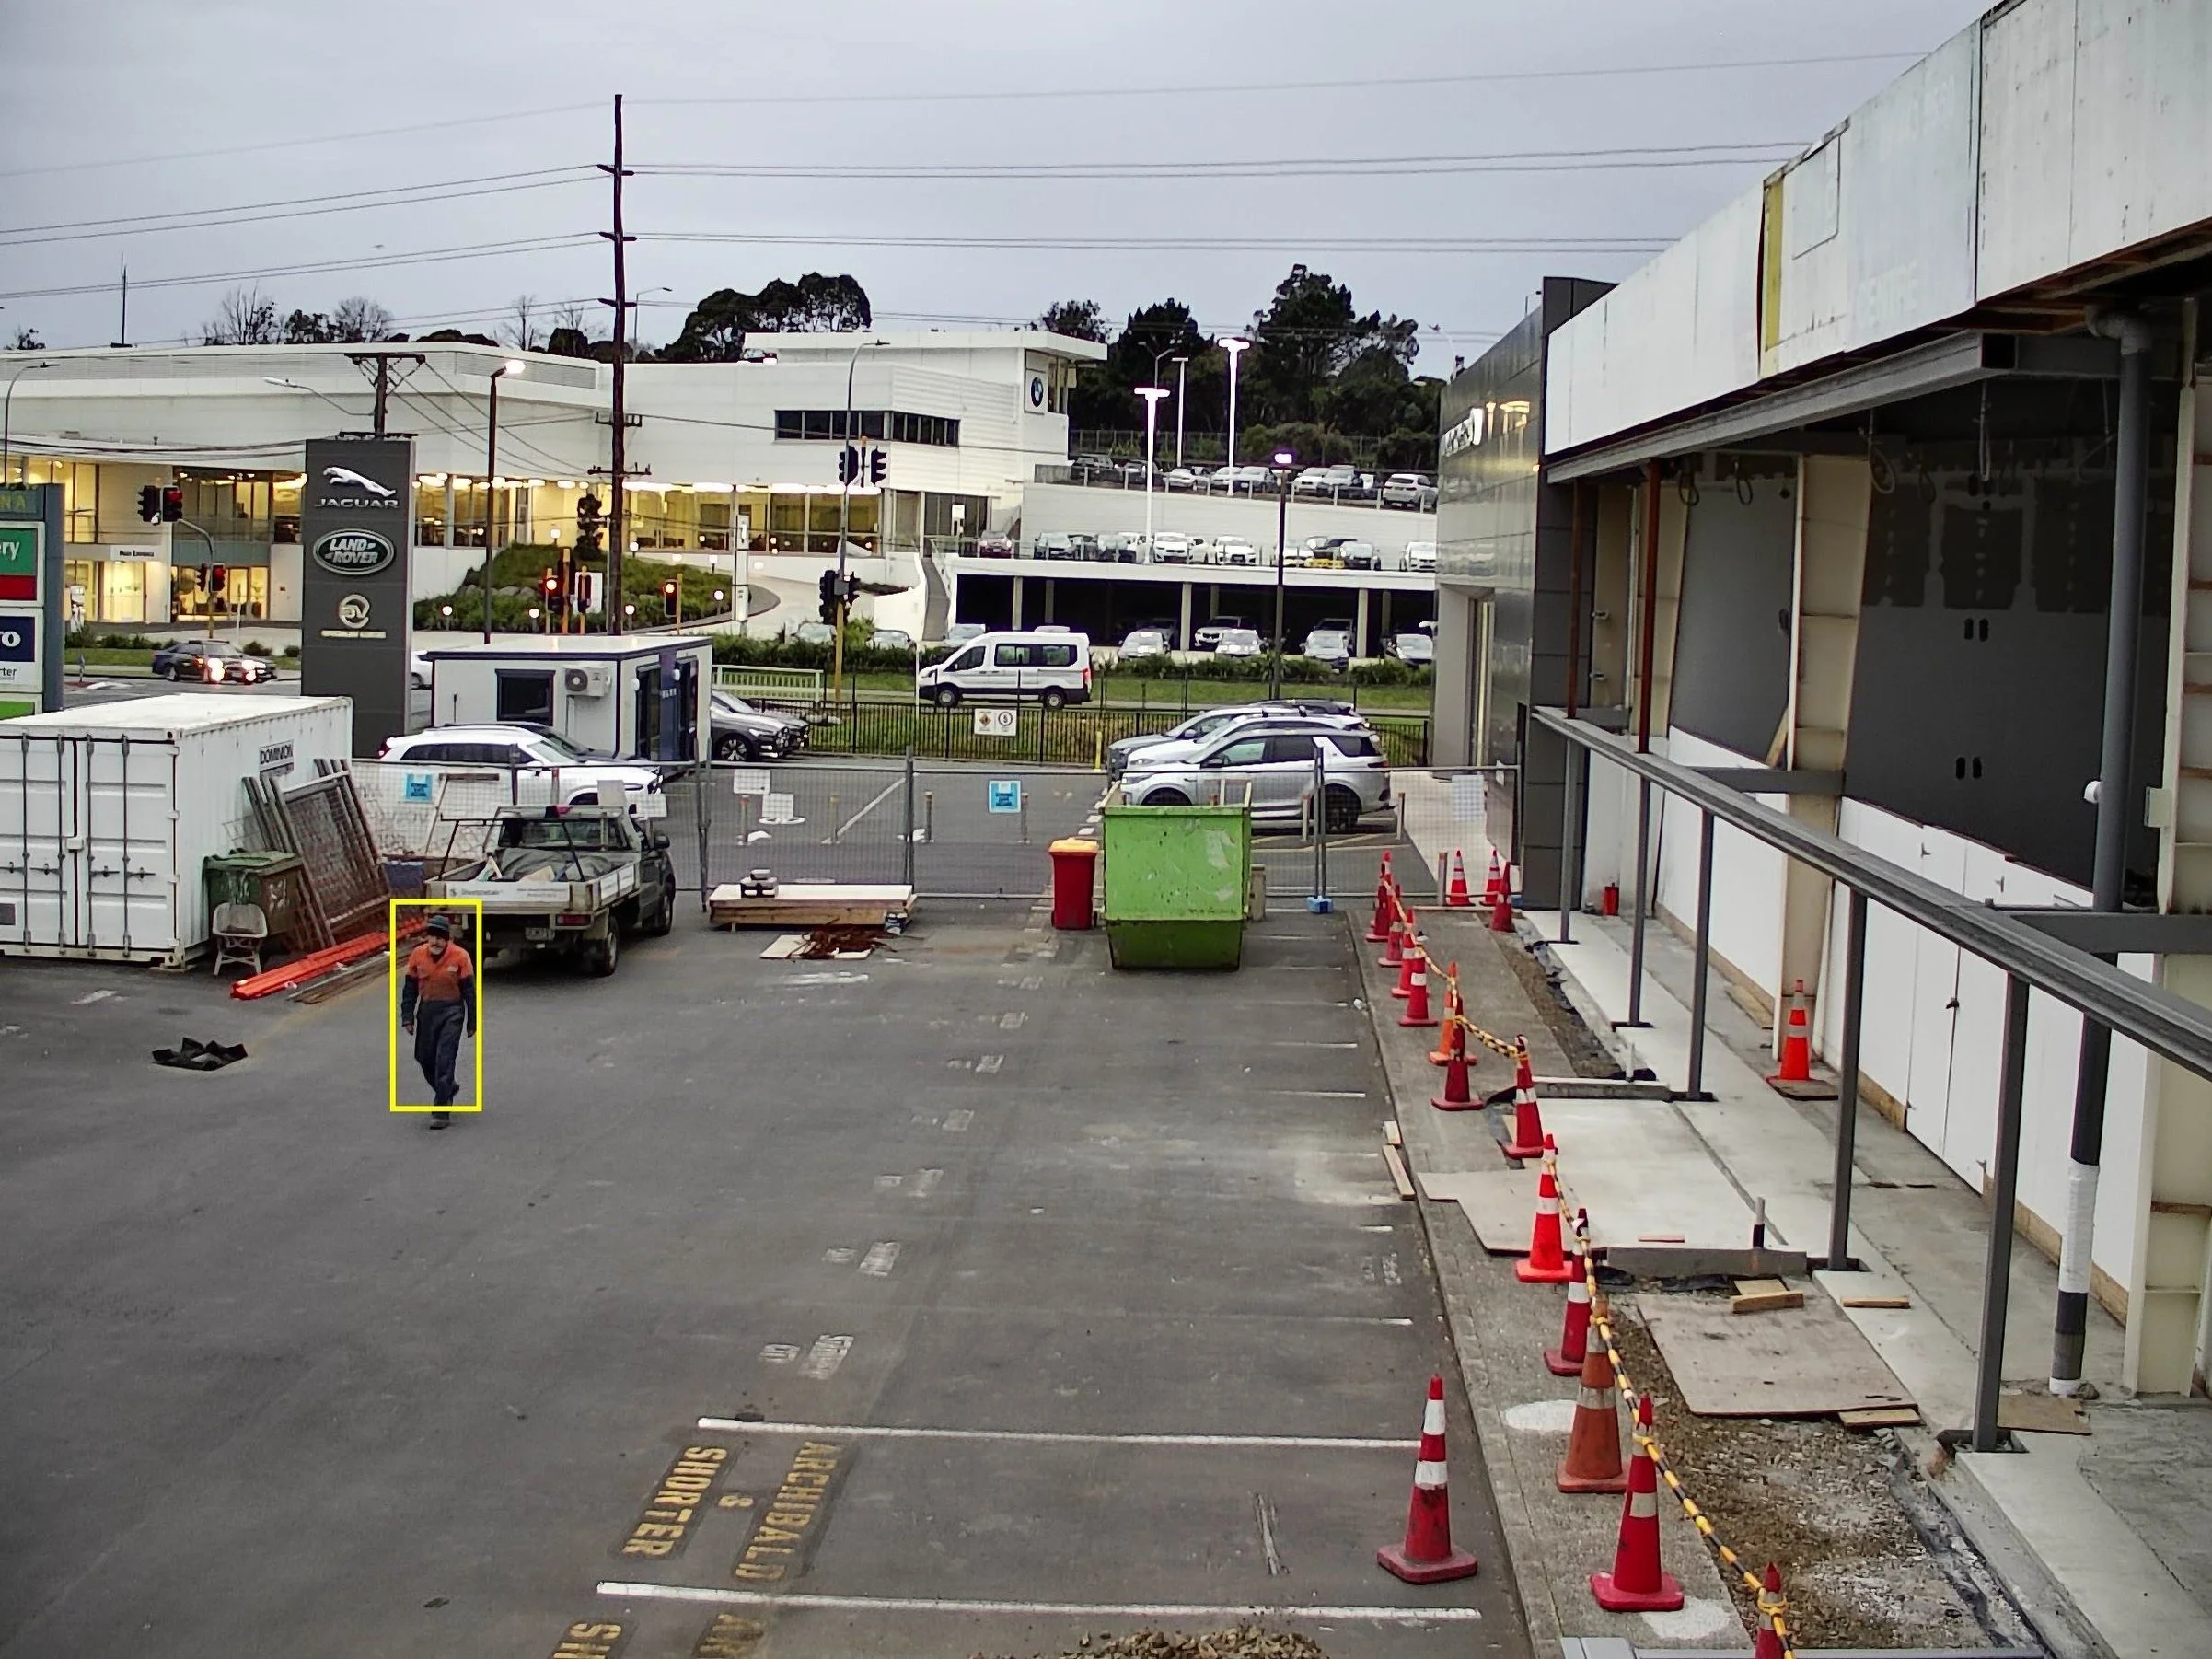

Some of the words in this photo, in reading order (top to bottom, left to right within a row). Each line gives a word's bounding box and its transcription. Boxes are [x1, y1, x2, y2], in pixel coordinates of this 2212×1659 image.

[315, 498, 399, 509] JAGUAR
[0, 541, 20, 561] ry
[330, 539, 367, 551] LAND
[332, 552, 379, 564] ROVER
[620, 1445, 727, 1556] SHORTER
[735, 1440, 843, 1582] ARCHIBALD
